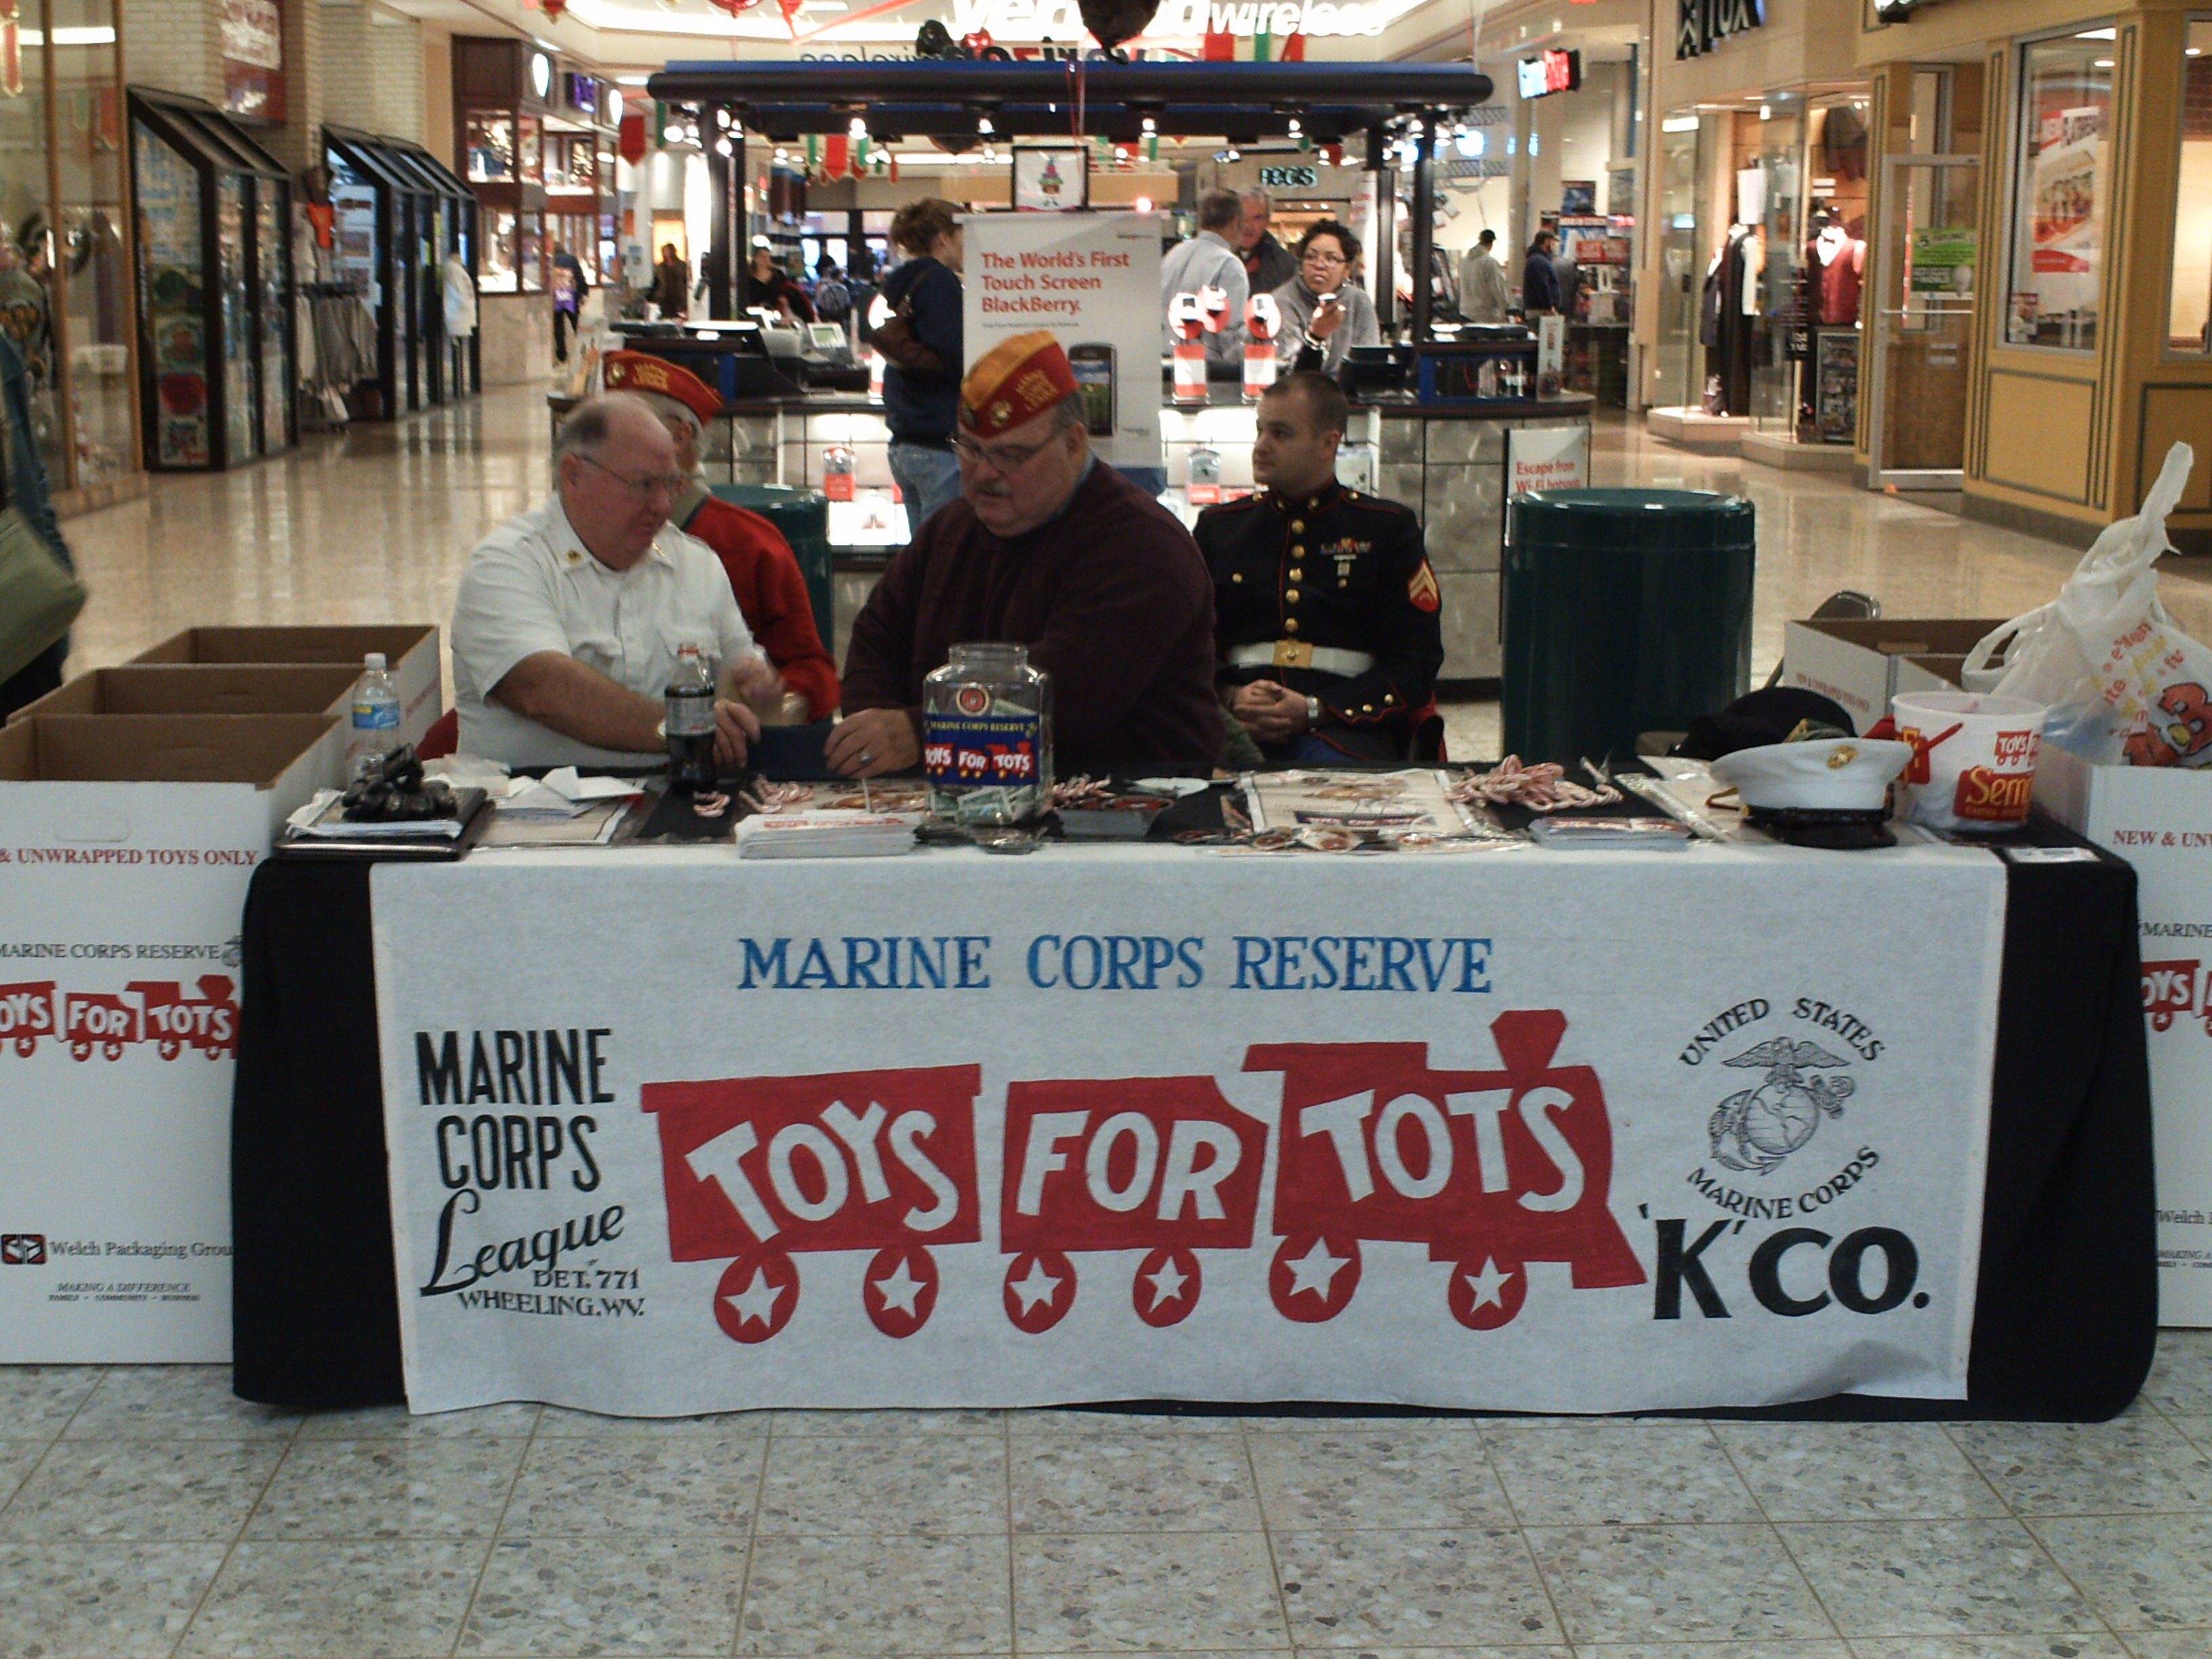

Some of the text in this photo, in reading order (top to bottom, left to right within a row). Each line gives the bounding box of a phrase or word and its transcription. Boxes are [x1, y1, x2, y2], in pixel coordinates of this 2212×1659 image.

[981, 251, 1130, 268] The World's First
[981, 274, 1102, 291] Touch Screen
[1516, 462, 1553, 476] Escape
[1999, 735, 2028, 754] TOYS
[958, 750, 987, 769] FOR
[993, 753, 1030, 771] TOTS
[2112, 830, 2158, 845] NEW
[2160, 832, 2176, 846] &
[17, 848, 142, 864] UNWRAPPED
[146, 849, 199, 865] TOYS
[203, 850, 259, 865] ONLY
[70, 943, 134, 959] CORPS
[136, 944, 221, 960] RESERVE
[737, 933, 1492, 994] MARINE CORPS RESERVE
[68, 1000, 131, 1038] FOR
[147, 1004, 232, 1042] TOTS
[1679, 997, 1887, 1067] UNITED STATES
[415, 1027, 615, 1106] MARINE
[436, 1113, 601, 1193] CORPS
[684, 1086, 1585, 1244] TOYS FOR TOTS
[1685, 1145, 1881, 1220] MARINE CORPS
[49, 1241, 102, 1257] Welch
[105, 1241, 189, 1260] Packaging
[419, 1188, 625, 1297] League
[57, 1282, 191, 1293] MAKING A DIFFERENCE
[532, 1267, 640, 1290] DET. 771
